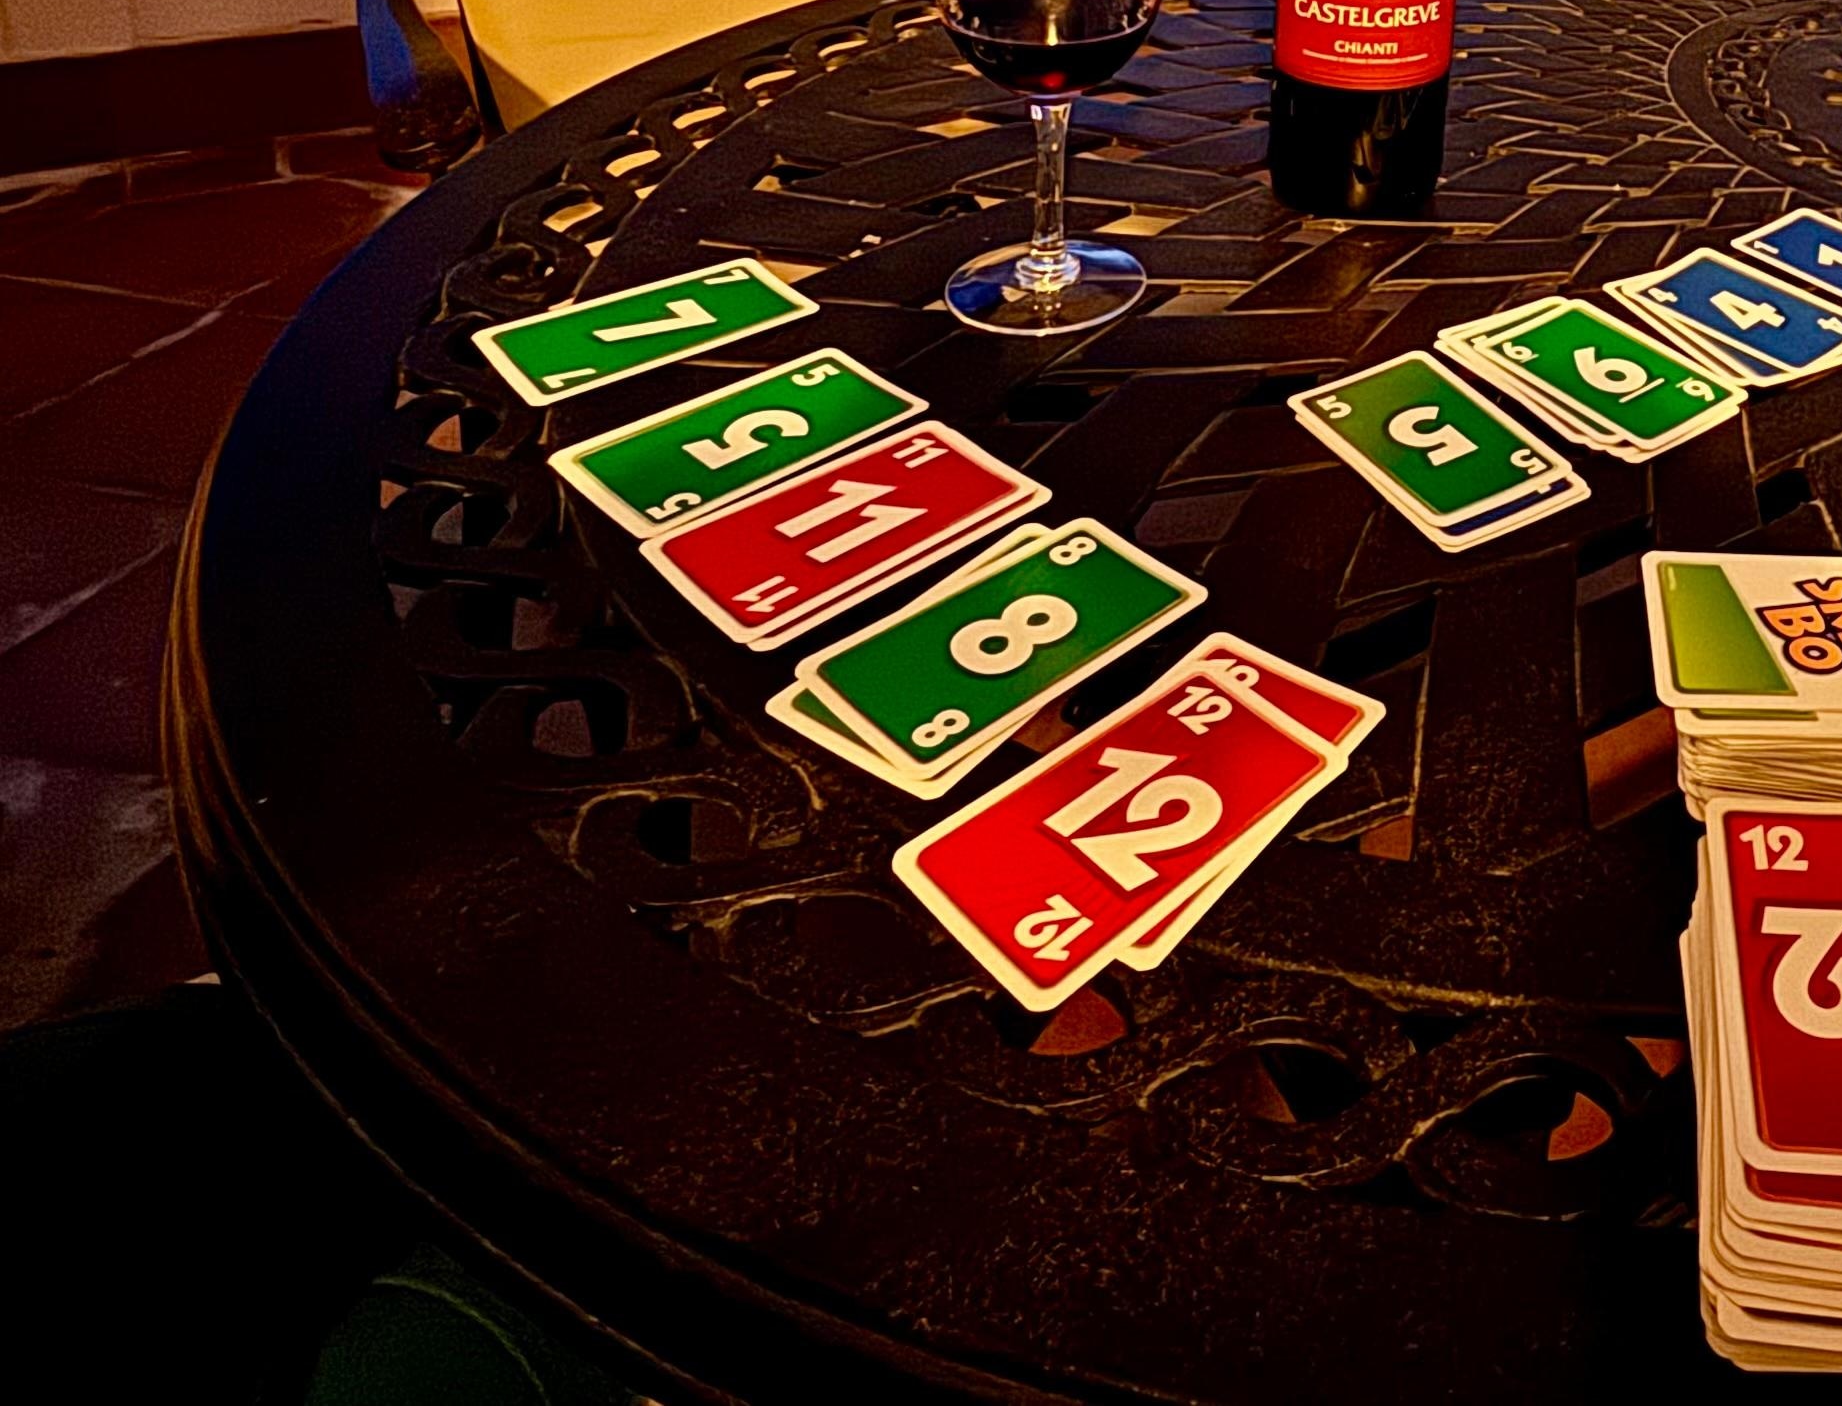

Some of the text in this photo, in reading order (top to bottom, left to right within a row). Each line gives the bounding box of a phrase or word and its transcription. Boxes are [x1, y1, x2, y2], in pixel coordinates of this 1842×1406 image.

[1334, 40, 1398, 55] CHIANTI
[1753, 240, 1779, 255] 1
[703, 268, 749, 285] 7
[1647, 287, 1678, 304] 4
[1709, 290, 1786, 330] 4
[593, 299, 717, 341] 7
[1502, 341, 1540, 364] 6
[541, 368, 597, 389] 7
[791, 364, 840, 386] 5
[1573, 346, 1665, 404] 6
[1674, 377, 1716, 402] 6
[1316, 395, 1353, 419] 5
[681, 409, 809, 470] 5
[1388, 405, 1480, 467] 5
[893, 438, 949, 469] 11
[1509, 448, 1549, 475] 5
[645, 492, 703, 520] 5
[774, 479, 928, 564] 11
[1049, 536, 1098, 566] 8
[732, 575, 799, 613] 11
[949, 594, 1078, 675] 8
[1166, 684, 1234, 737] 12
[911, 708, 971, 748] 8
[1042, 746, 1224, 893] 12
[1739, 825, 1809, 872] 12
[1013, 893, 1095, 963] 12
